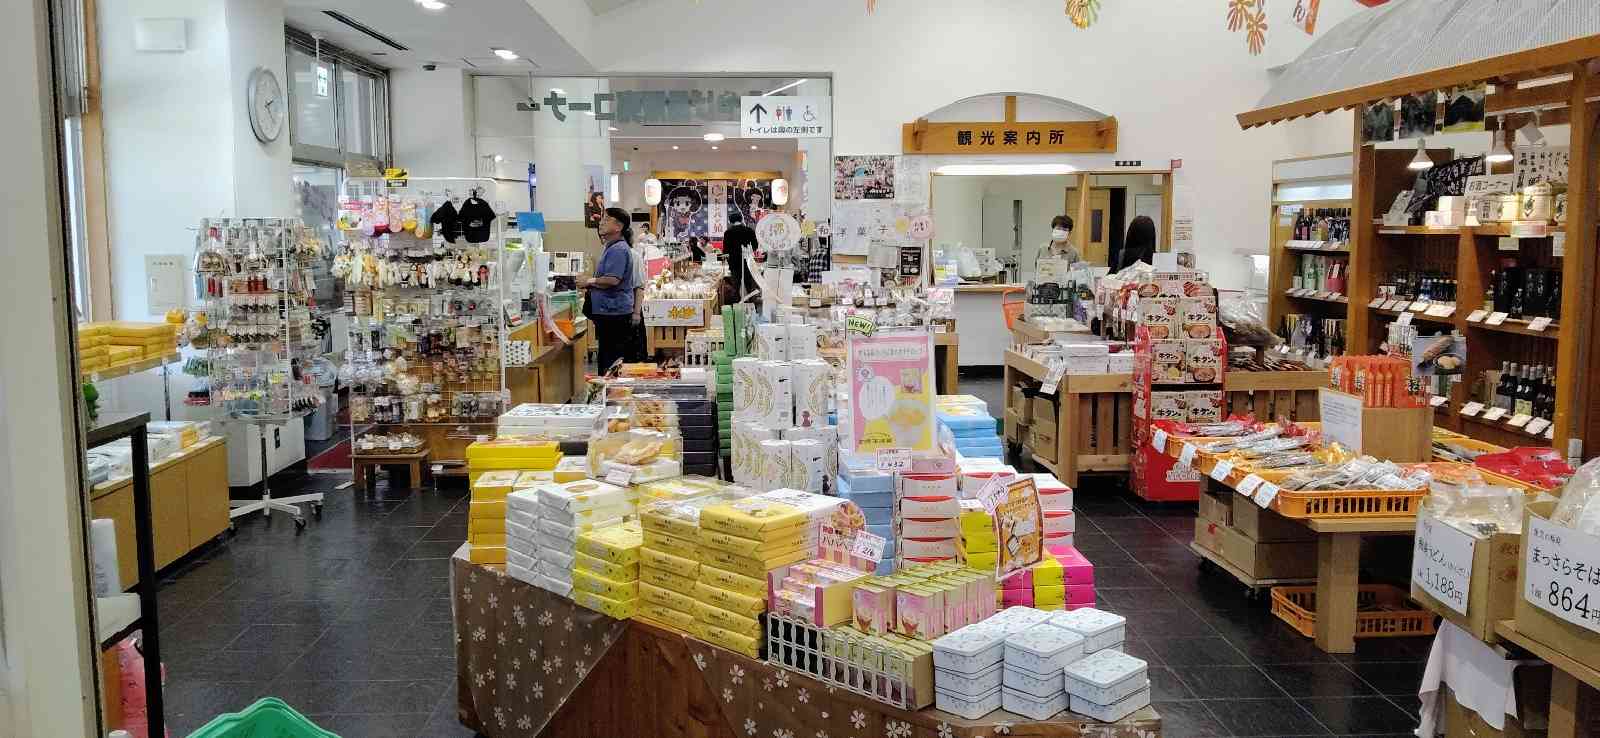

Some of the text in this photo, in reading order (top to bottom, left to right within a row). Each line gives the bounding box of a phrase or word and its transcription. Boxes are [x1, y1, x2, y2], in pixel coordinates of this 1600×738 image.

[957, 129, 1065, 146] 観光案内所
[848, 318, 873, 333] NEW!
